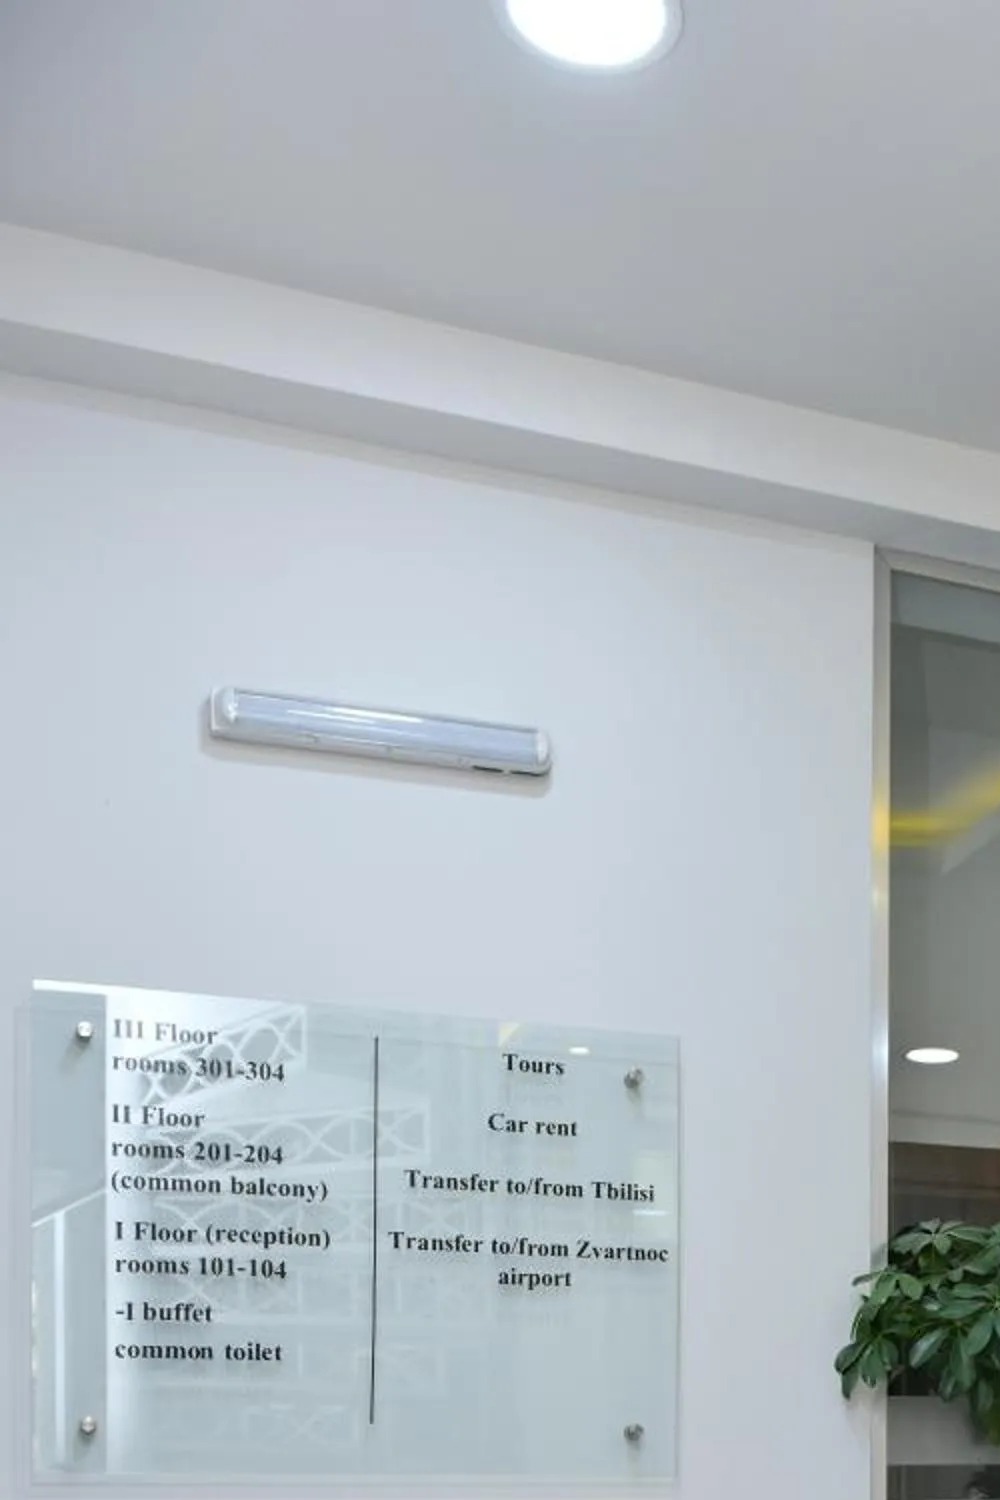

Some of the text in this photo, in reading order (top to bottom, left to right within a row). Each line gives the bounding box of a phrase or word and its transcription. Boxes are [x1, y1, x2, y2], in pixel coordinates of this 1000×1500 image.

[113, 1018, 219, 1045] III Floor
[112, 1055, 285, 1082] rooms 301-304
[502, 1053, 565, 1076] Tours
[112, 1103, 205, 1127] II Floor
[488, 1112, 578, 1137] Car rent
[111, 1140, 283, 1165] rooms 201-204
[111, 1172, 329, 1203] (common balcony)
[404, 1169, 655, 1203] Transfer to/from Tbilisi
[134, 1222, 198, 1243] Floor
[205, 1224, 331, 1250] (reception)
[388, 1231, 669, 1263] Transfer to/from Zvartnoc
[115, 1256, 287, 1280] rooms 101-104
[498, 1267, 572, 1291] airport
[143, 1302, 213, 1323] buffet
[115, 1342, 282, 1362] common toilet
